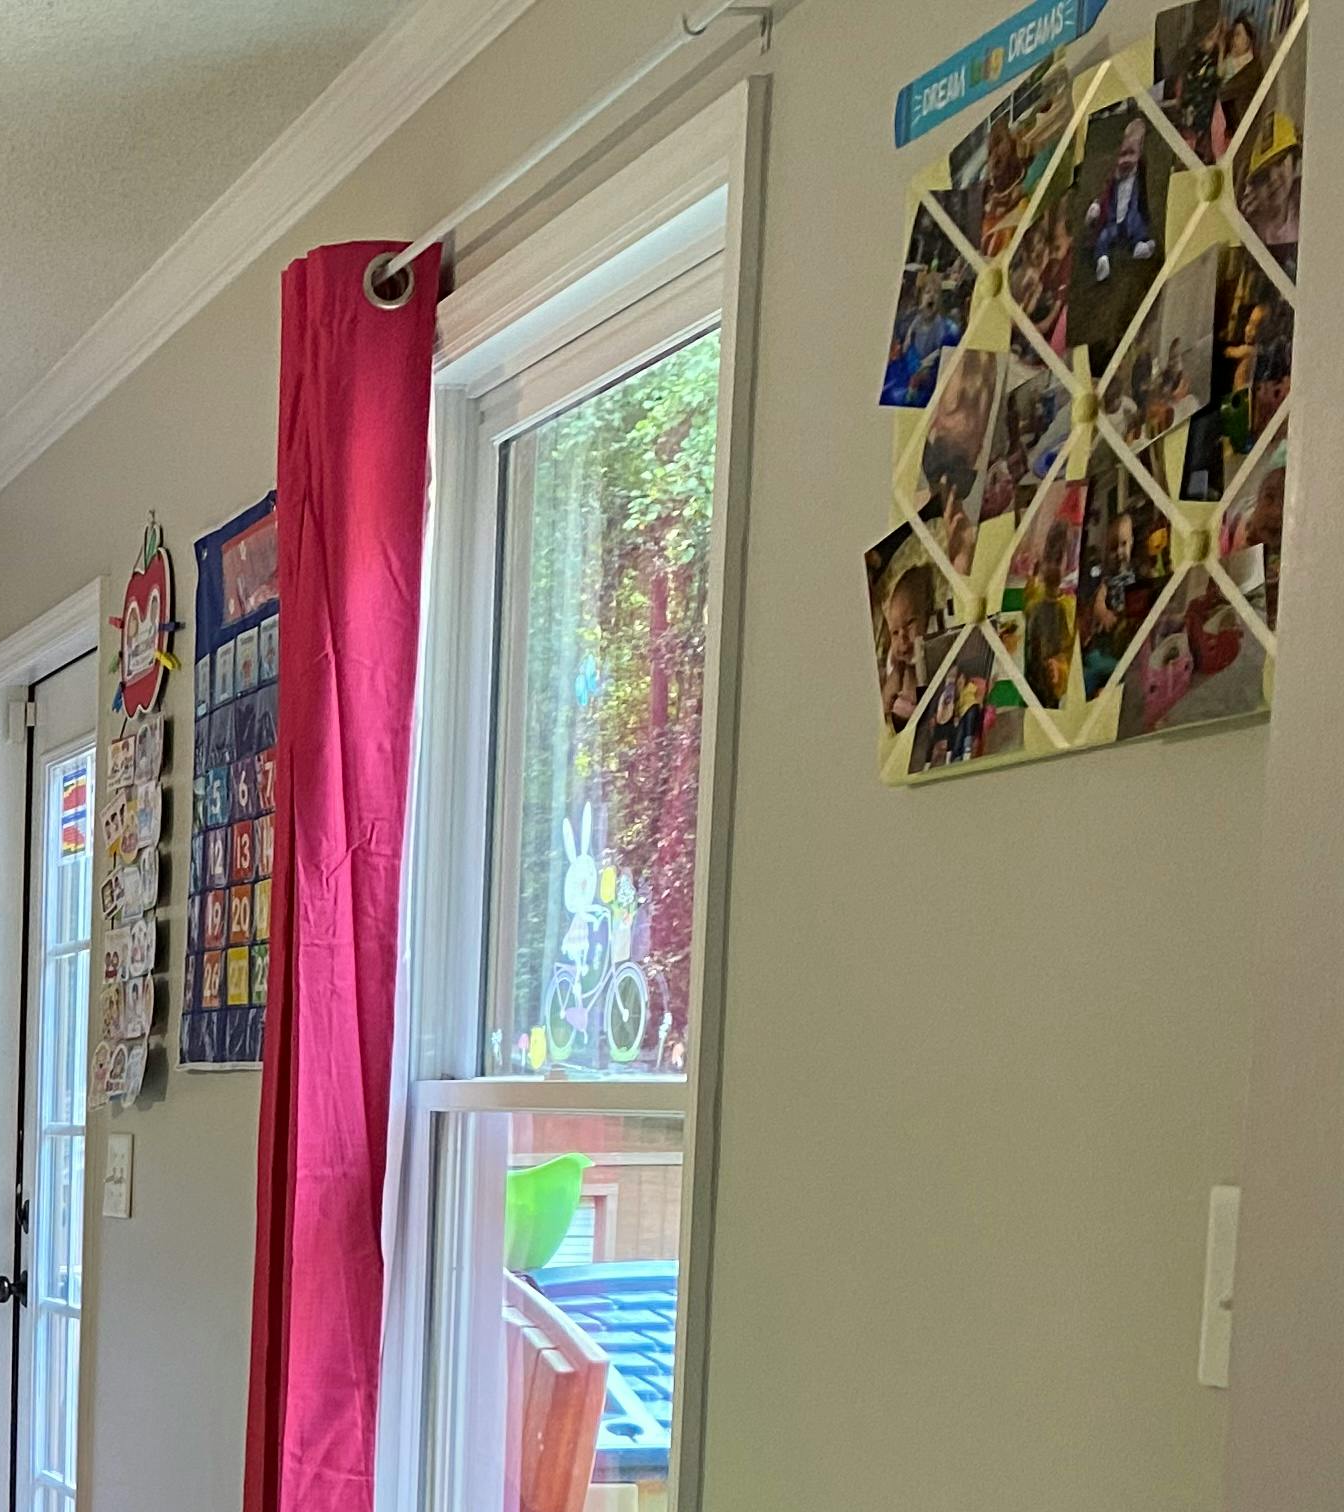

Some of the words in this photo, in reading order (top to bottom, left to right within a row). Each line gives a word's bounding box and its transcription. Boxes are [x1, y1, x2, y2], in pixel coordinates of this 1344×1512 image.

[922, 64, 965, 116] DREAM
[1008, 2, 1064, 63] DREAMS
[212, 780, 220, 814] 5
[239, 770, 248, 807] 6
[264, 760, 272, 798] 7
[237, 833, 250, 869] 13
[232, 897, 250, 932] 20
